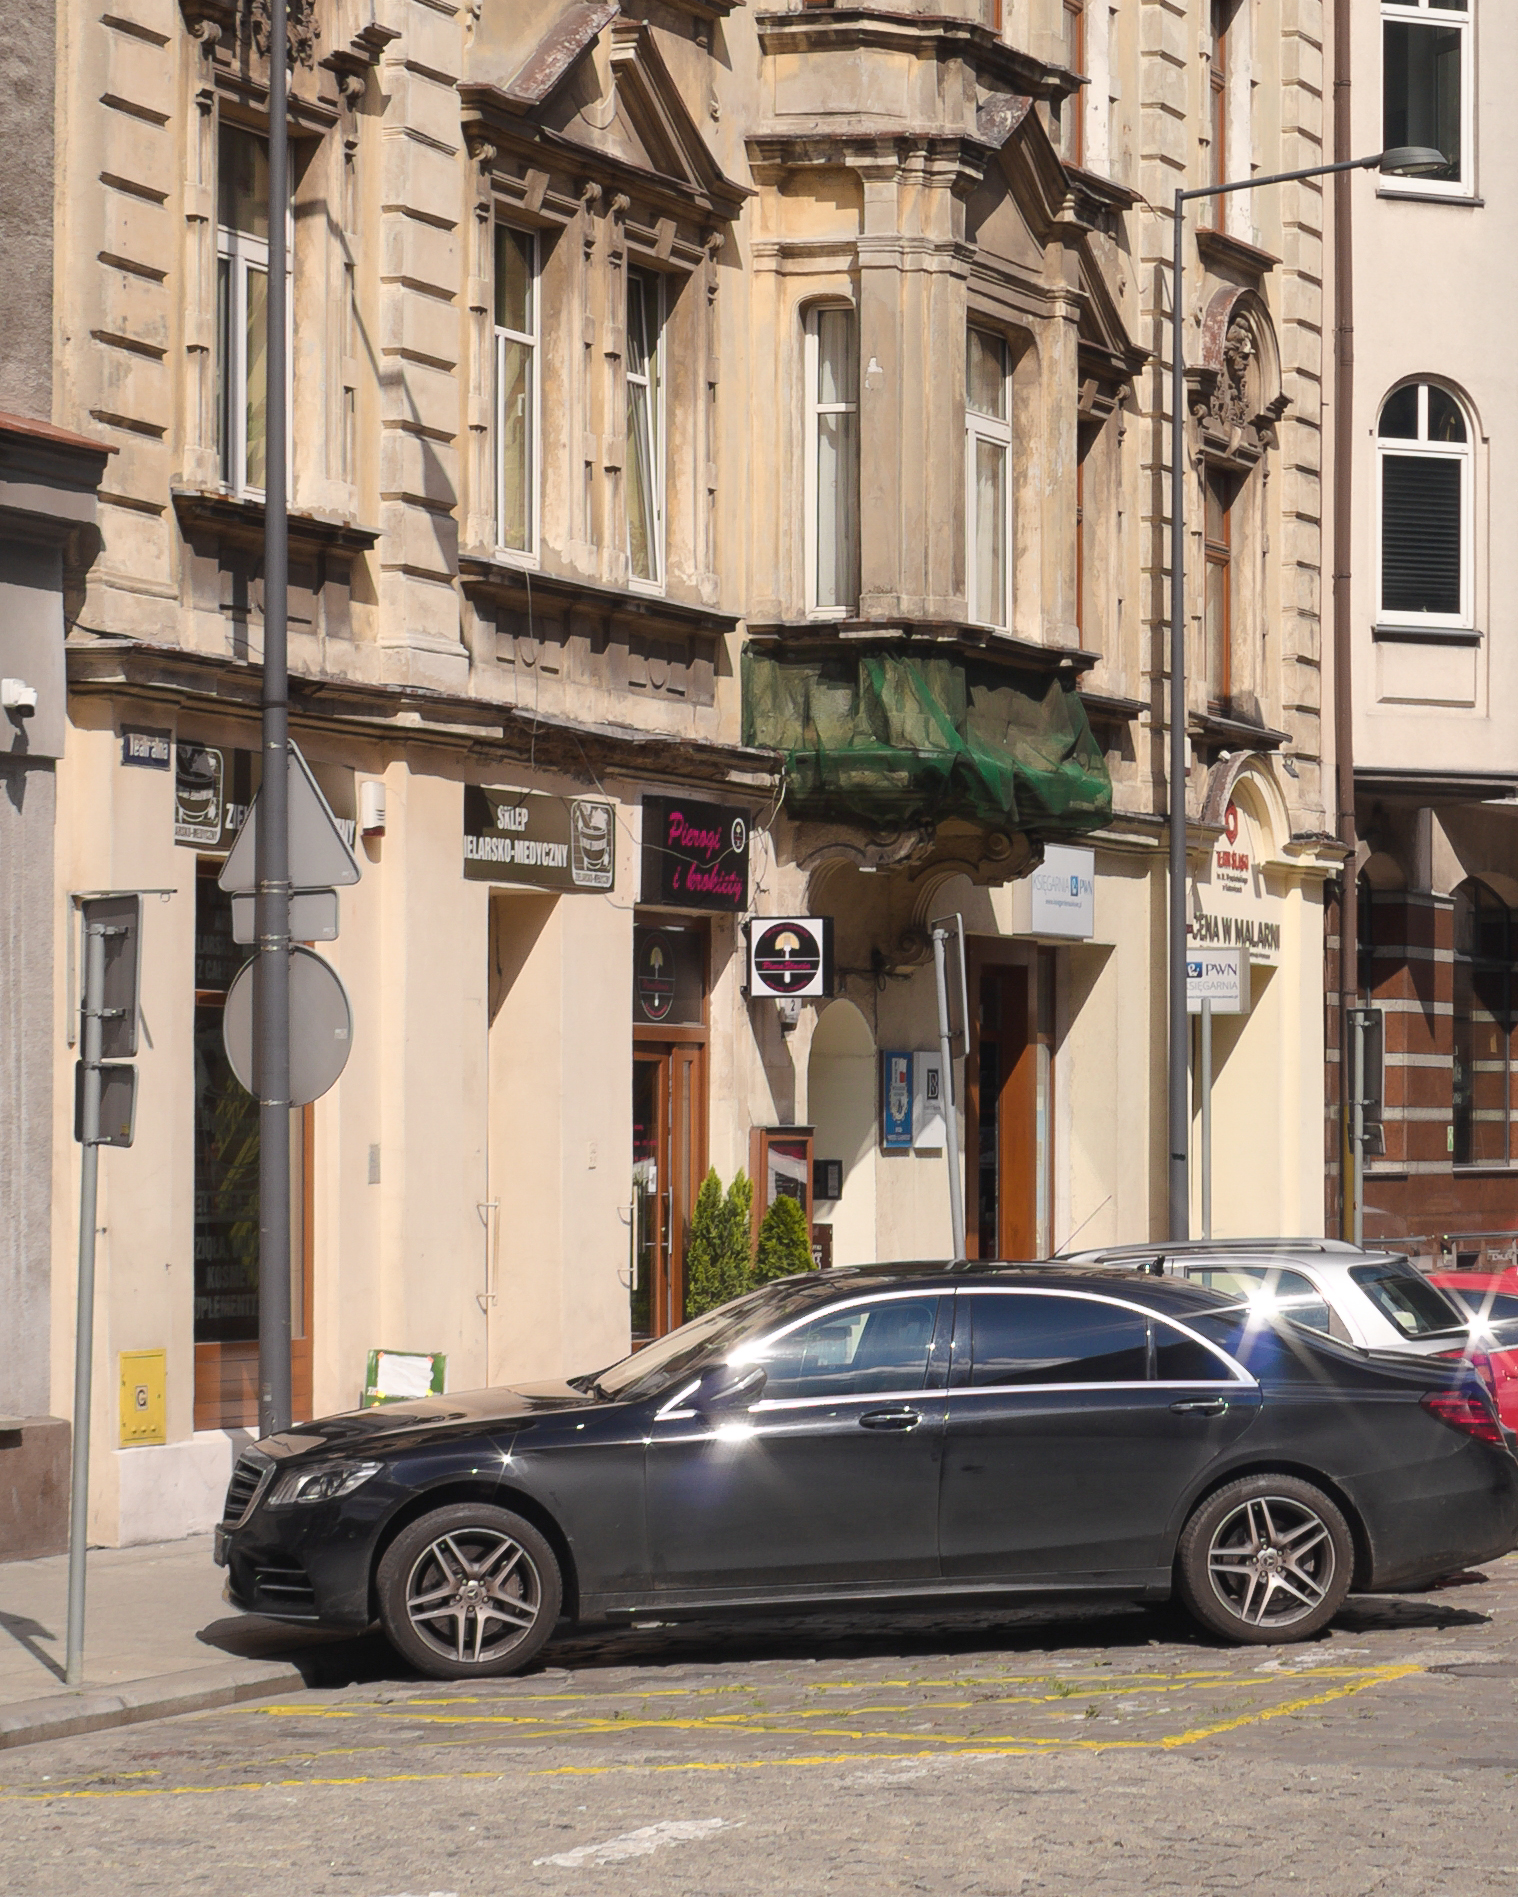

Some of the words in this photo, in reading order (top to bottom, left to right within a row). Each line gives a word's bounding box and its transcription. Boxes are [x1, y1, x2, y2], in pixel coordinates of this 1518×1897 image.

[497, 805, 529, 832] SKLEP
[667, 810, 722, 860] Pierogi
[464, 835, 569, 868] IELARSKO-MEDYCZNY
[672, 865, 681, 890] i
[685, 860, 743, 903] krokiety
[1192, 912, 1220, 943] CENA
[1221, 916, 1232, 945] W
[1234, 918, 1280, 952] MALARNI
[1206, 963, 1238, 977] PWN
[1186, 981, 1238, 993] SIĘGARNIA
[790, 999, 797, 1012] 2
